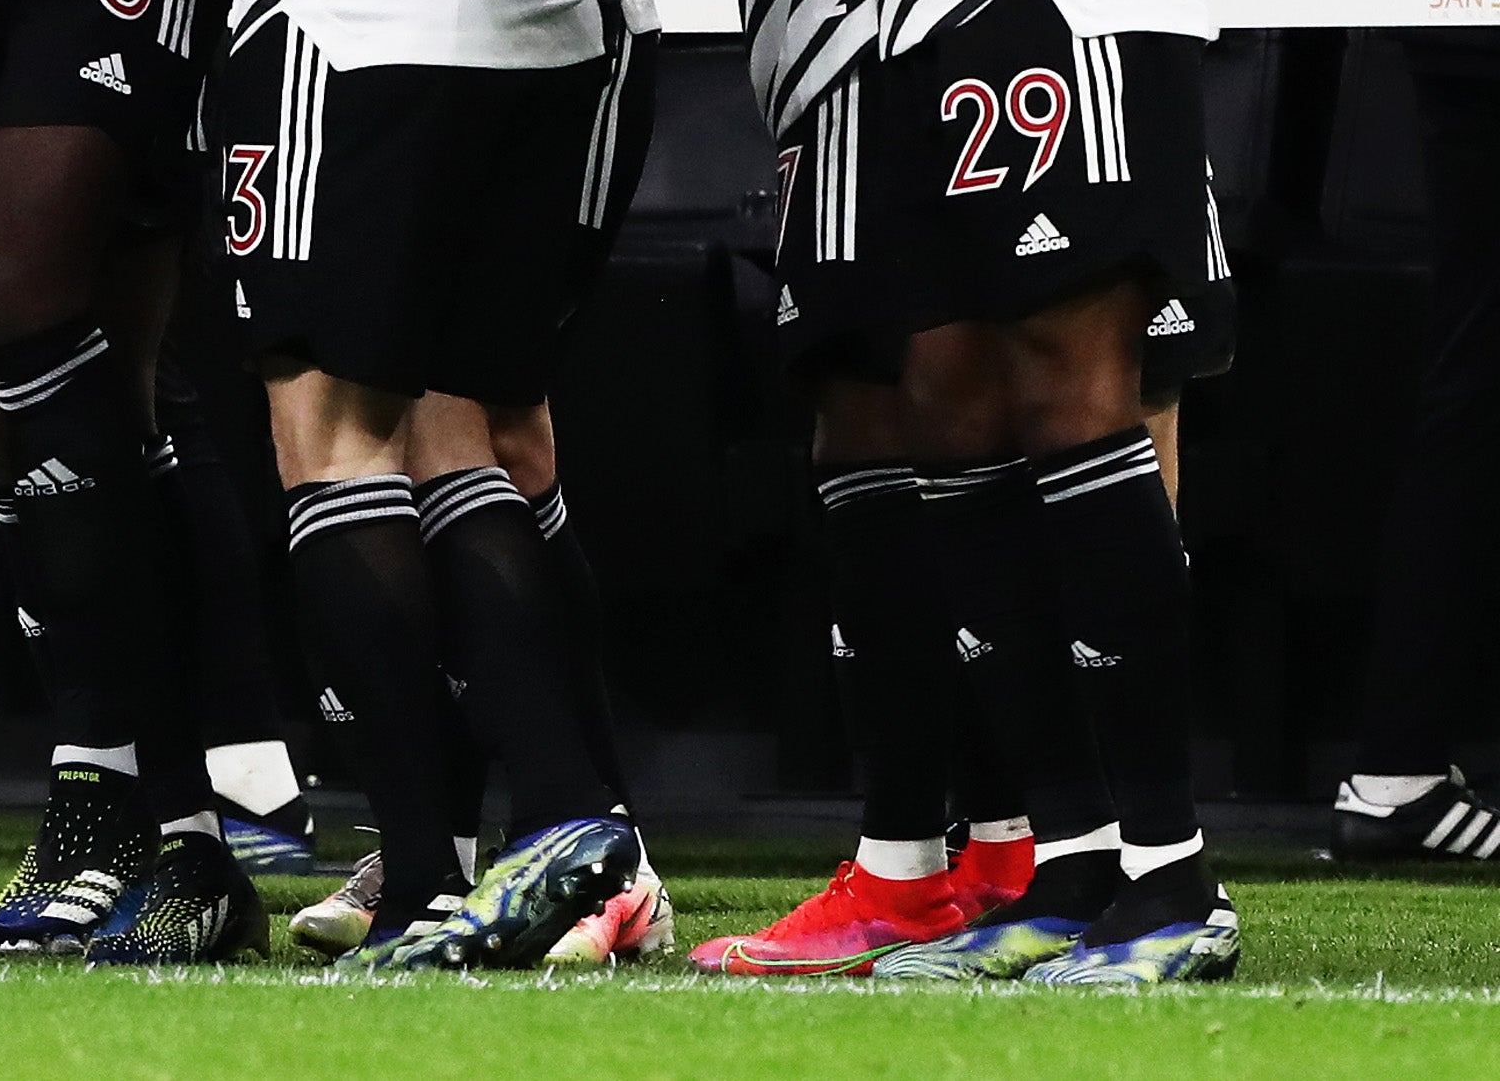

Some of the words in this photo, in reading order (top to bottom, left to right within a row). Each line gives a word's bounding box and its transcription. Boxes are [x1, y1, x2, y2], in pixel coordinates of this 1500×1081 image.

[79, 67, 132, 95] adidas
[940, 67, 1071, 197] 29
[223, 144, 275, 257] 3
[775, 144, 804, 267] 7
[1015, 236, 1070, 257] adidas
[1146, 320, 1196, 337] adidas
